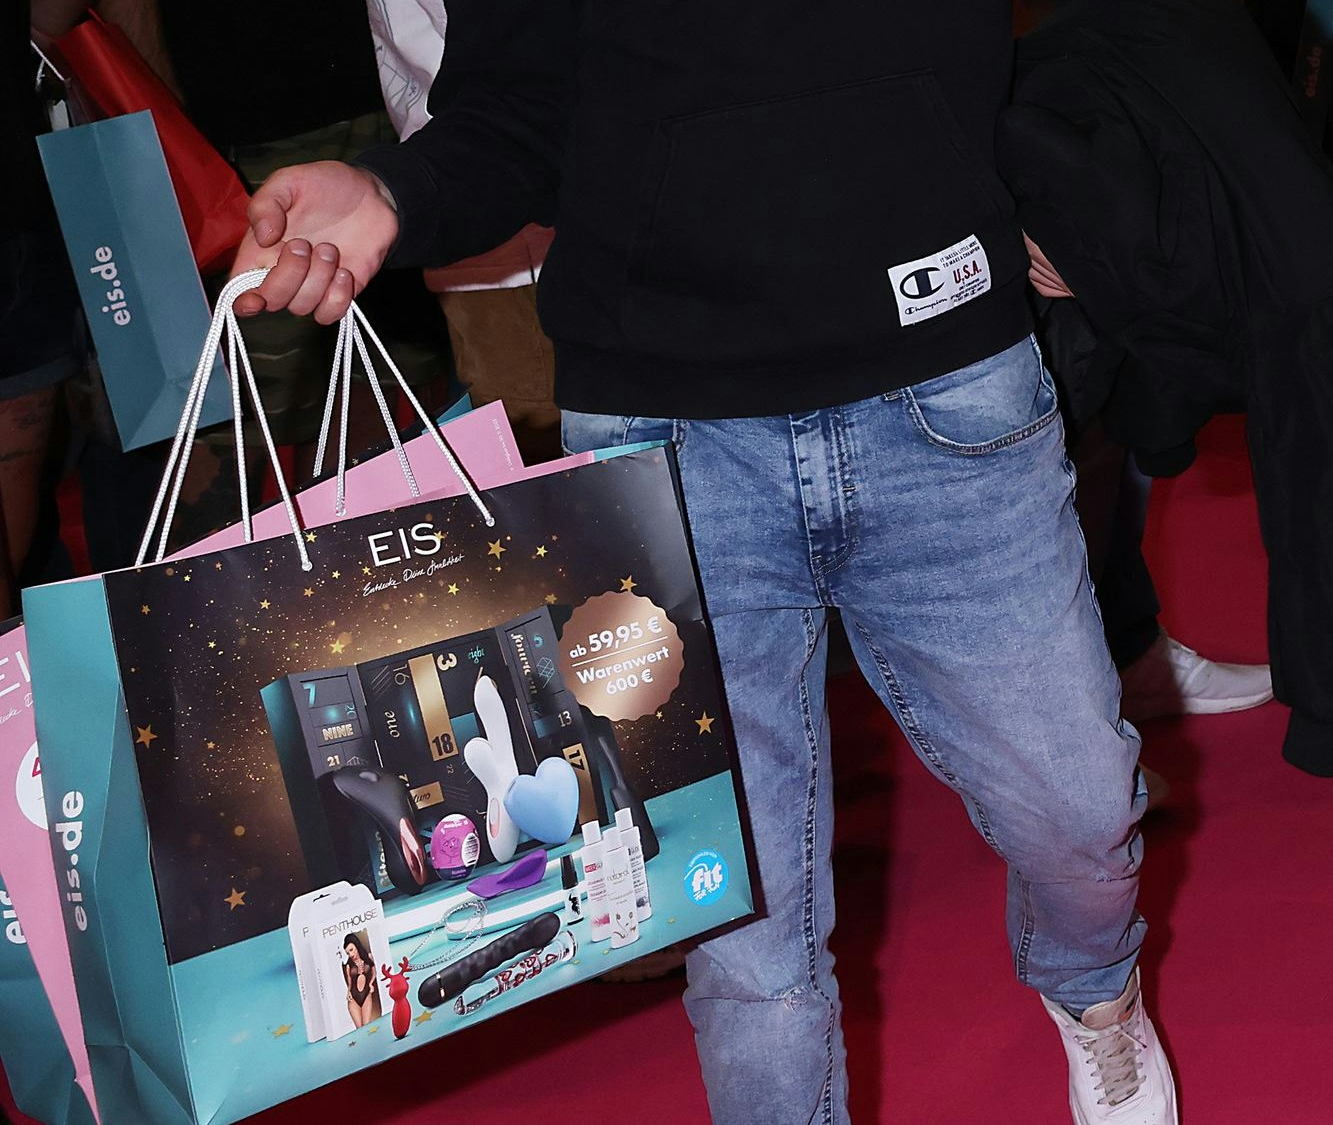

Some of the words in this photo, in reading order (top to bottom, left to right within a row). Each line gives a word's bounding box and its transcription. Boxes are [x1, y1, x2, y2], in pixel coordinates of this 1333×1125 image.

[90, 244, 131, 326] eis.de
[952, 259, 982, 284] U.S.A.
[904, 297, 948, 315] Champion
[367, 522, 442, 567] EIS
[363, 576, 402, 597] Entdecke
[403, 568, 426, 582] Deine
[569, 644, 587, 659] ab
[588, 621, 644, 652] 59,95
[646, 616, 662, 634] €
[436, 653, 458, 671] 3
[576, 646, 670, 684] Warenwert
[302, 682, 317, 708] 7
[606, 674, 639, 695] 600
[641, 668, 654, 683] €
[321, 723, 354, 741] NINE
[384, 709, 400, 738] one
[558, 710, 573, 728] 13
[431, 732, 454, 757] 18
[327, 754, 341, 767] 21
[55, 790, 88, 932] eis.de
[322, 907, 377, 939] PENTHOUSE
